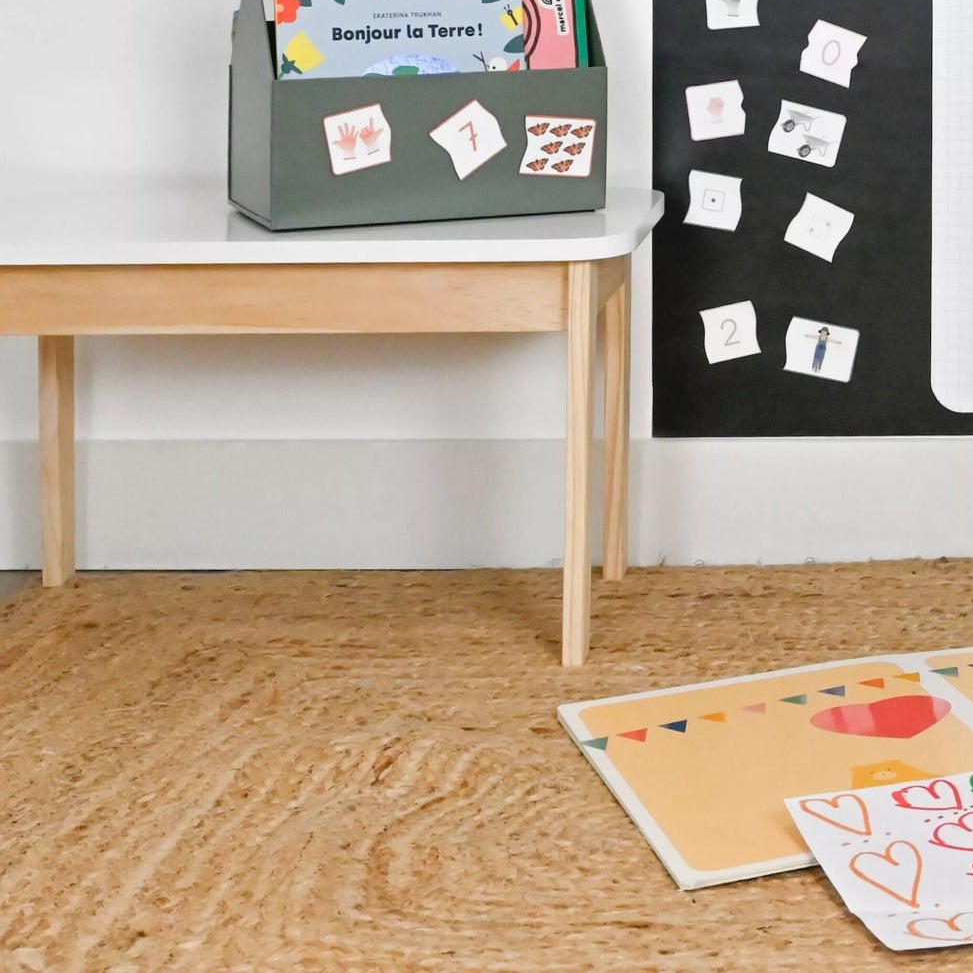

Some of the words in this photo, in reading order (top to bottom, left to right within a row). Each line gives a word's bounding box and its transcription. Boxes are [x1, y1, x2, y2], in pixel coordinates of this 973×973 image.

[372, 12, 408, 20] EKATERINA
[554, 4, 567, 33] marcel
[331, 25, 402, 44] Bonjour
[406, 24, 424, 39] la
[821, 39, 841, 66] 0
[458, 120, 478, 152] 7
[719, 318, 741, 347] 2
